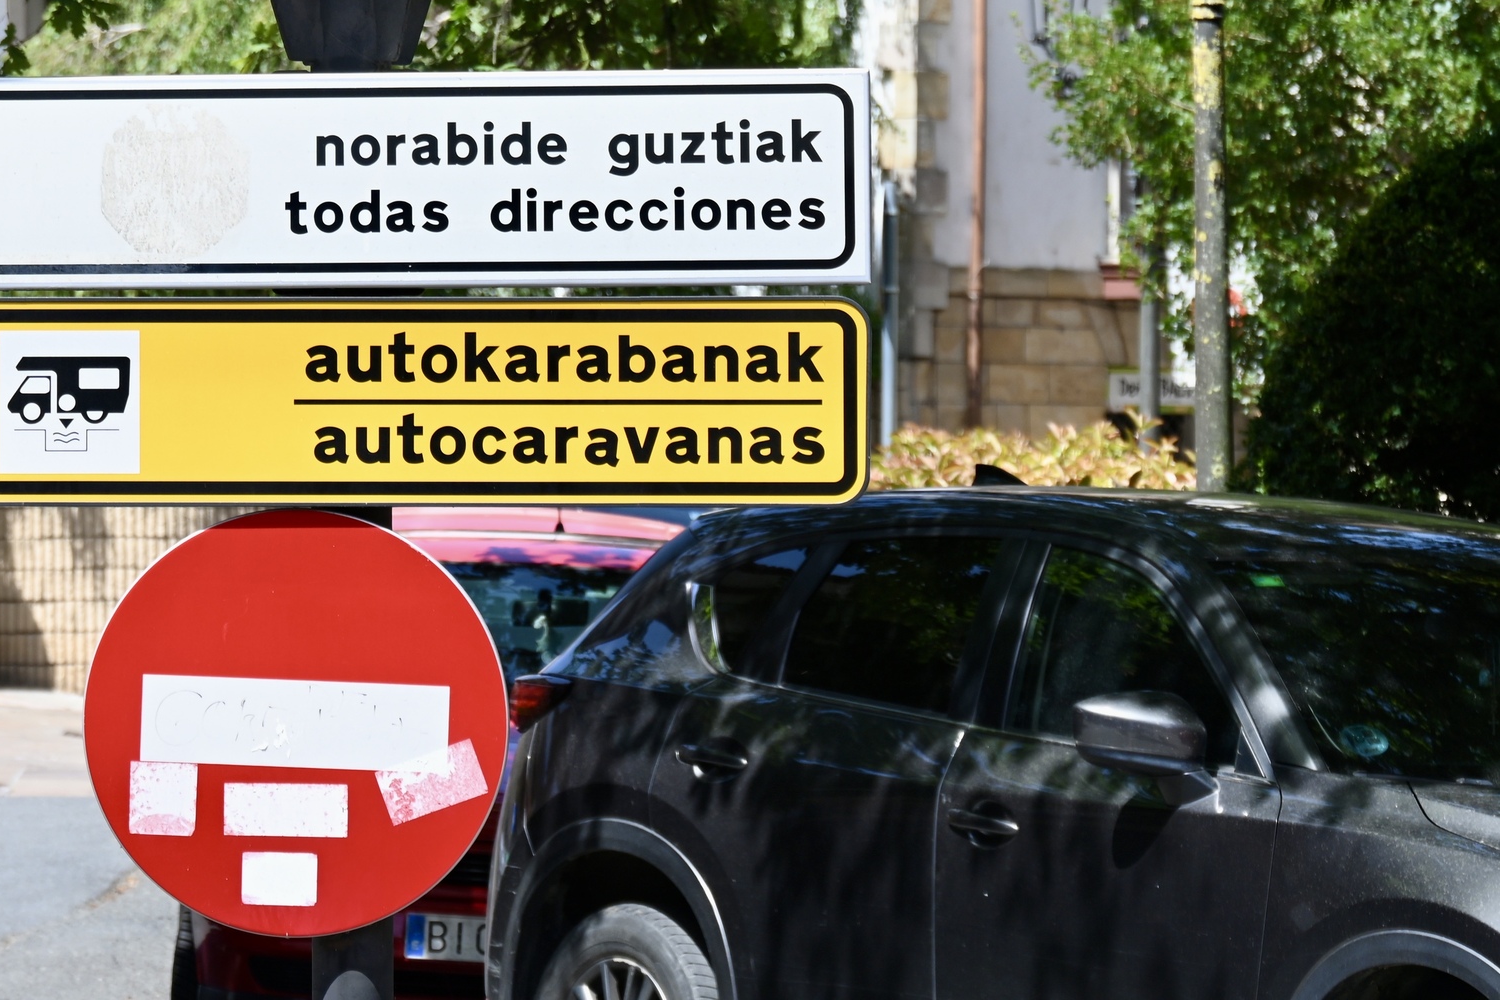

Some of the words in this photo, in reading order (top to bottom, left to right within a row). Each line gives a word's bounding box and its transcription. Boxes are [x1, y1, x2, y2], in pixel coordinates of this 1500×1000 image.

[316, 121, 567, 166] norabide
[608, 118, 823, 177] guztiak
[285, 189, 449, 235] todas
[490, 186, 826, 233] direcciones
[305, 331, 824, 384] autokarabanak
[314, 413, 825, 468] autocaravanas
